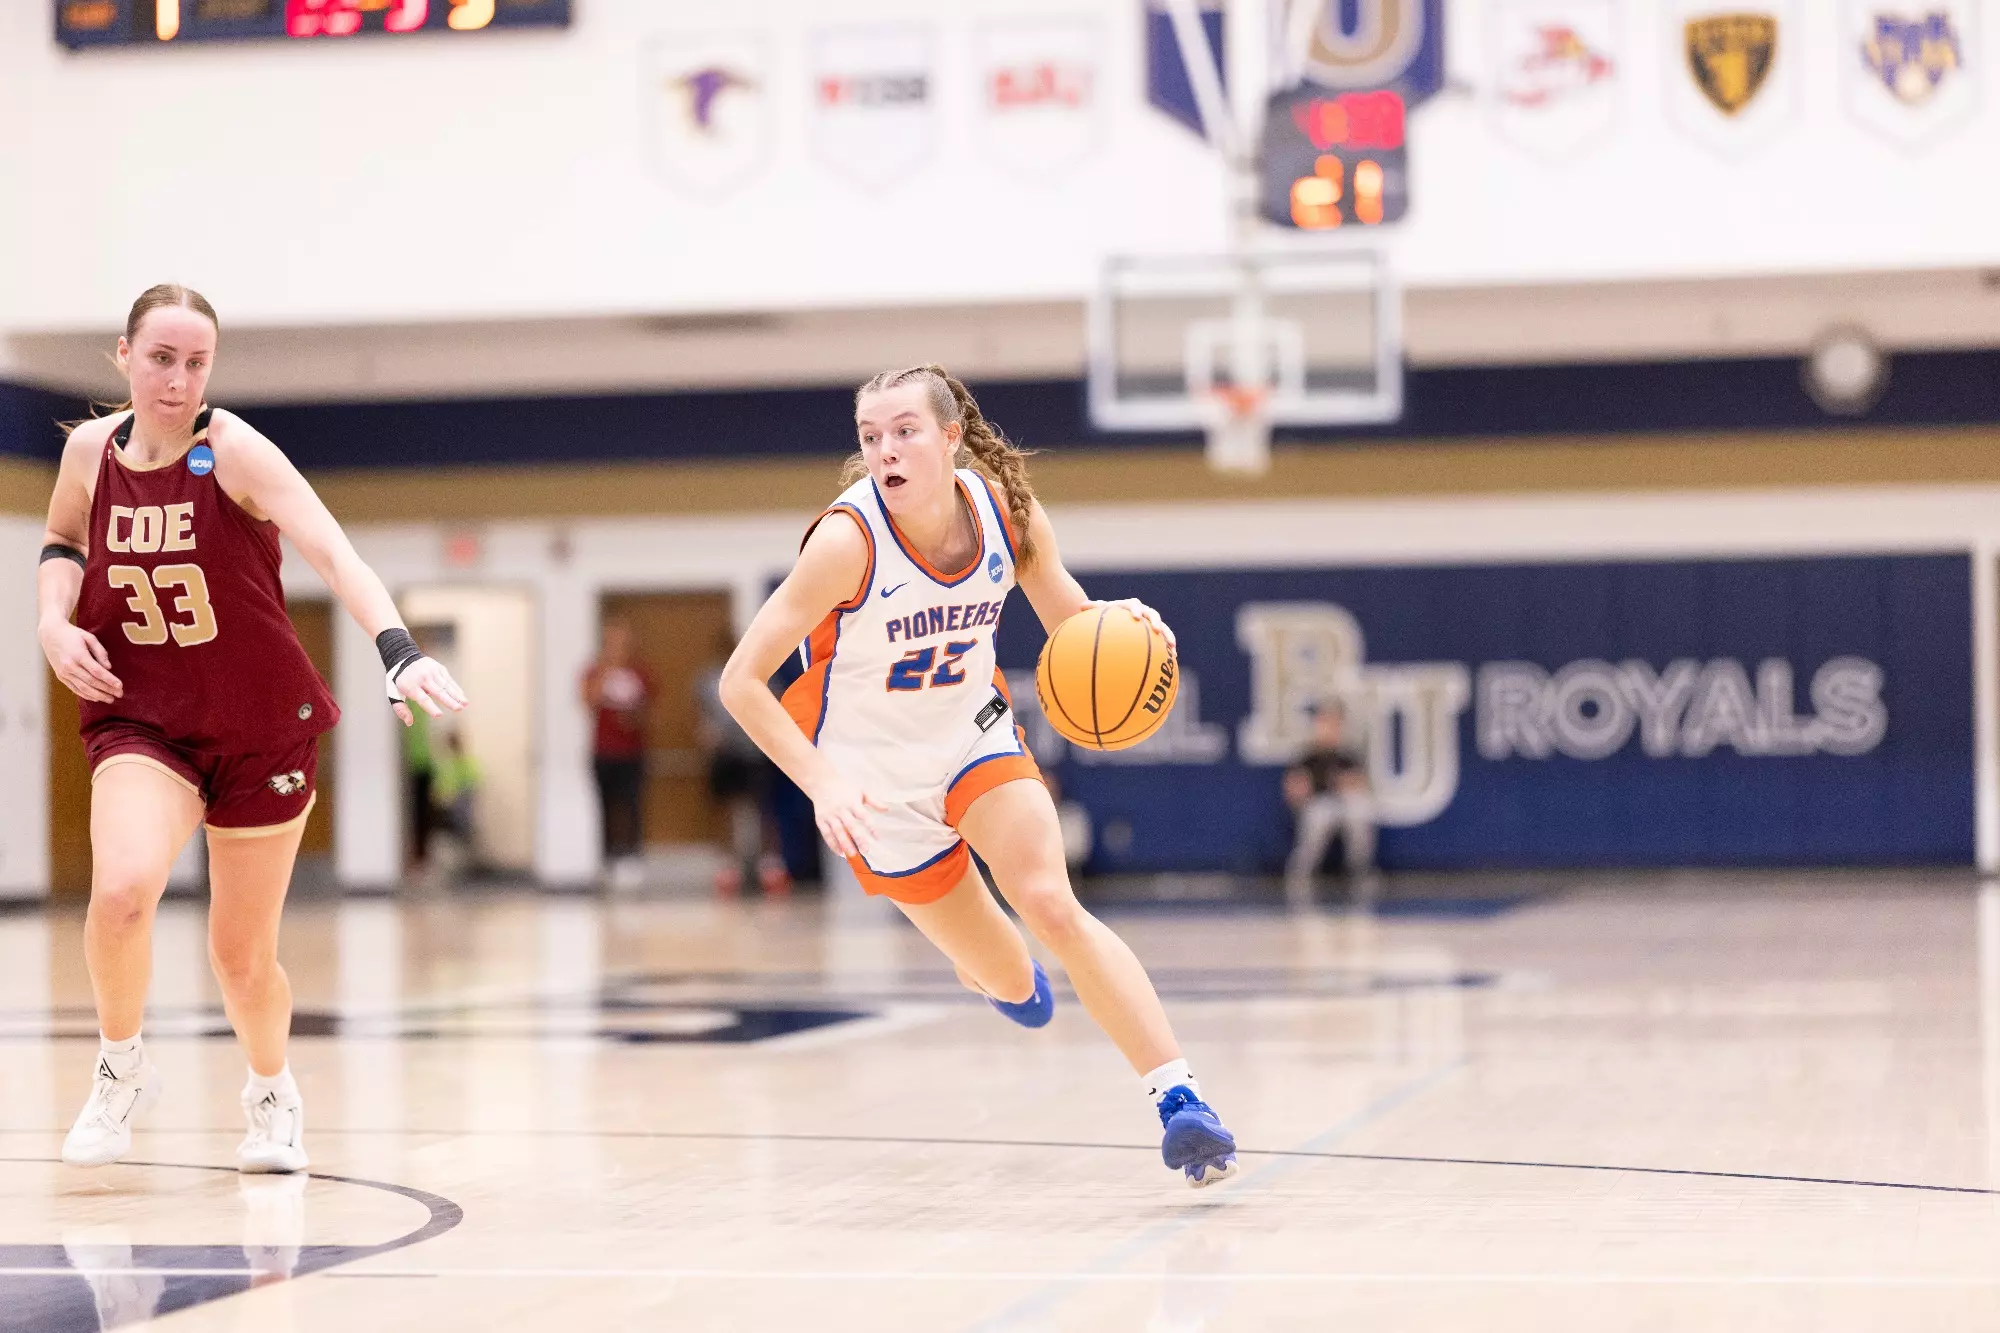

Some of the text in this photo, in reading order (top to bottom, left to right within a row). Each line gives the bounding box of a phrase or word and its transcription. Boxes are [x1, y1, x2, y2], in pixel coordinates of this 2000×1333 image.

[190, 459, 213, 469] NCAA
[106, 502, 197, 554] COE
[107, 563, 218, 648] 33
[886, 599, 1003, 643] PIONEERS
[886, 638, 979, 692] 22
[1142, 643, 1175, 714] Wilso
[1476, 654, 1888, 760] ROYALS
